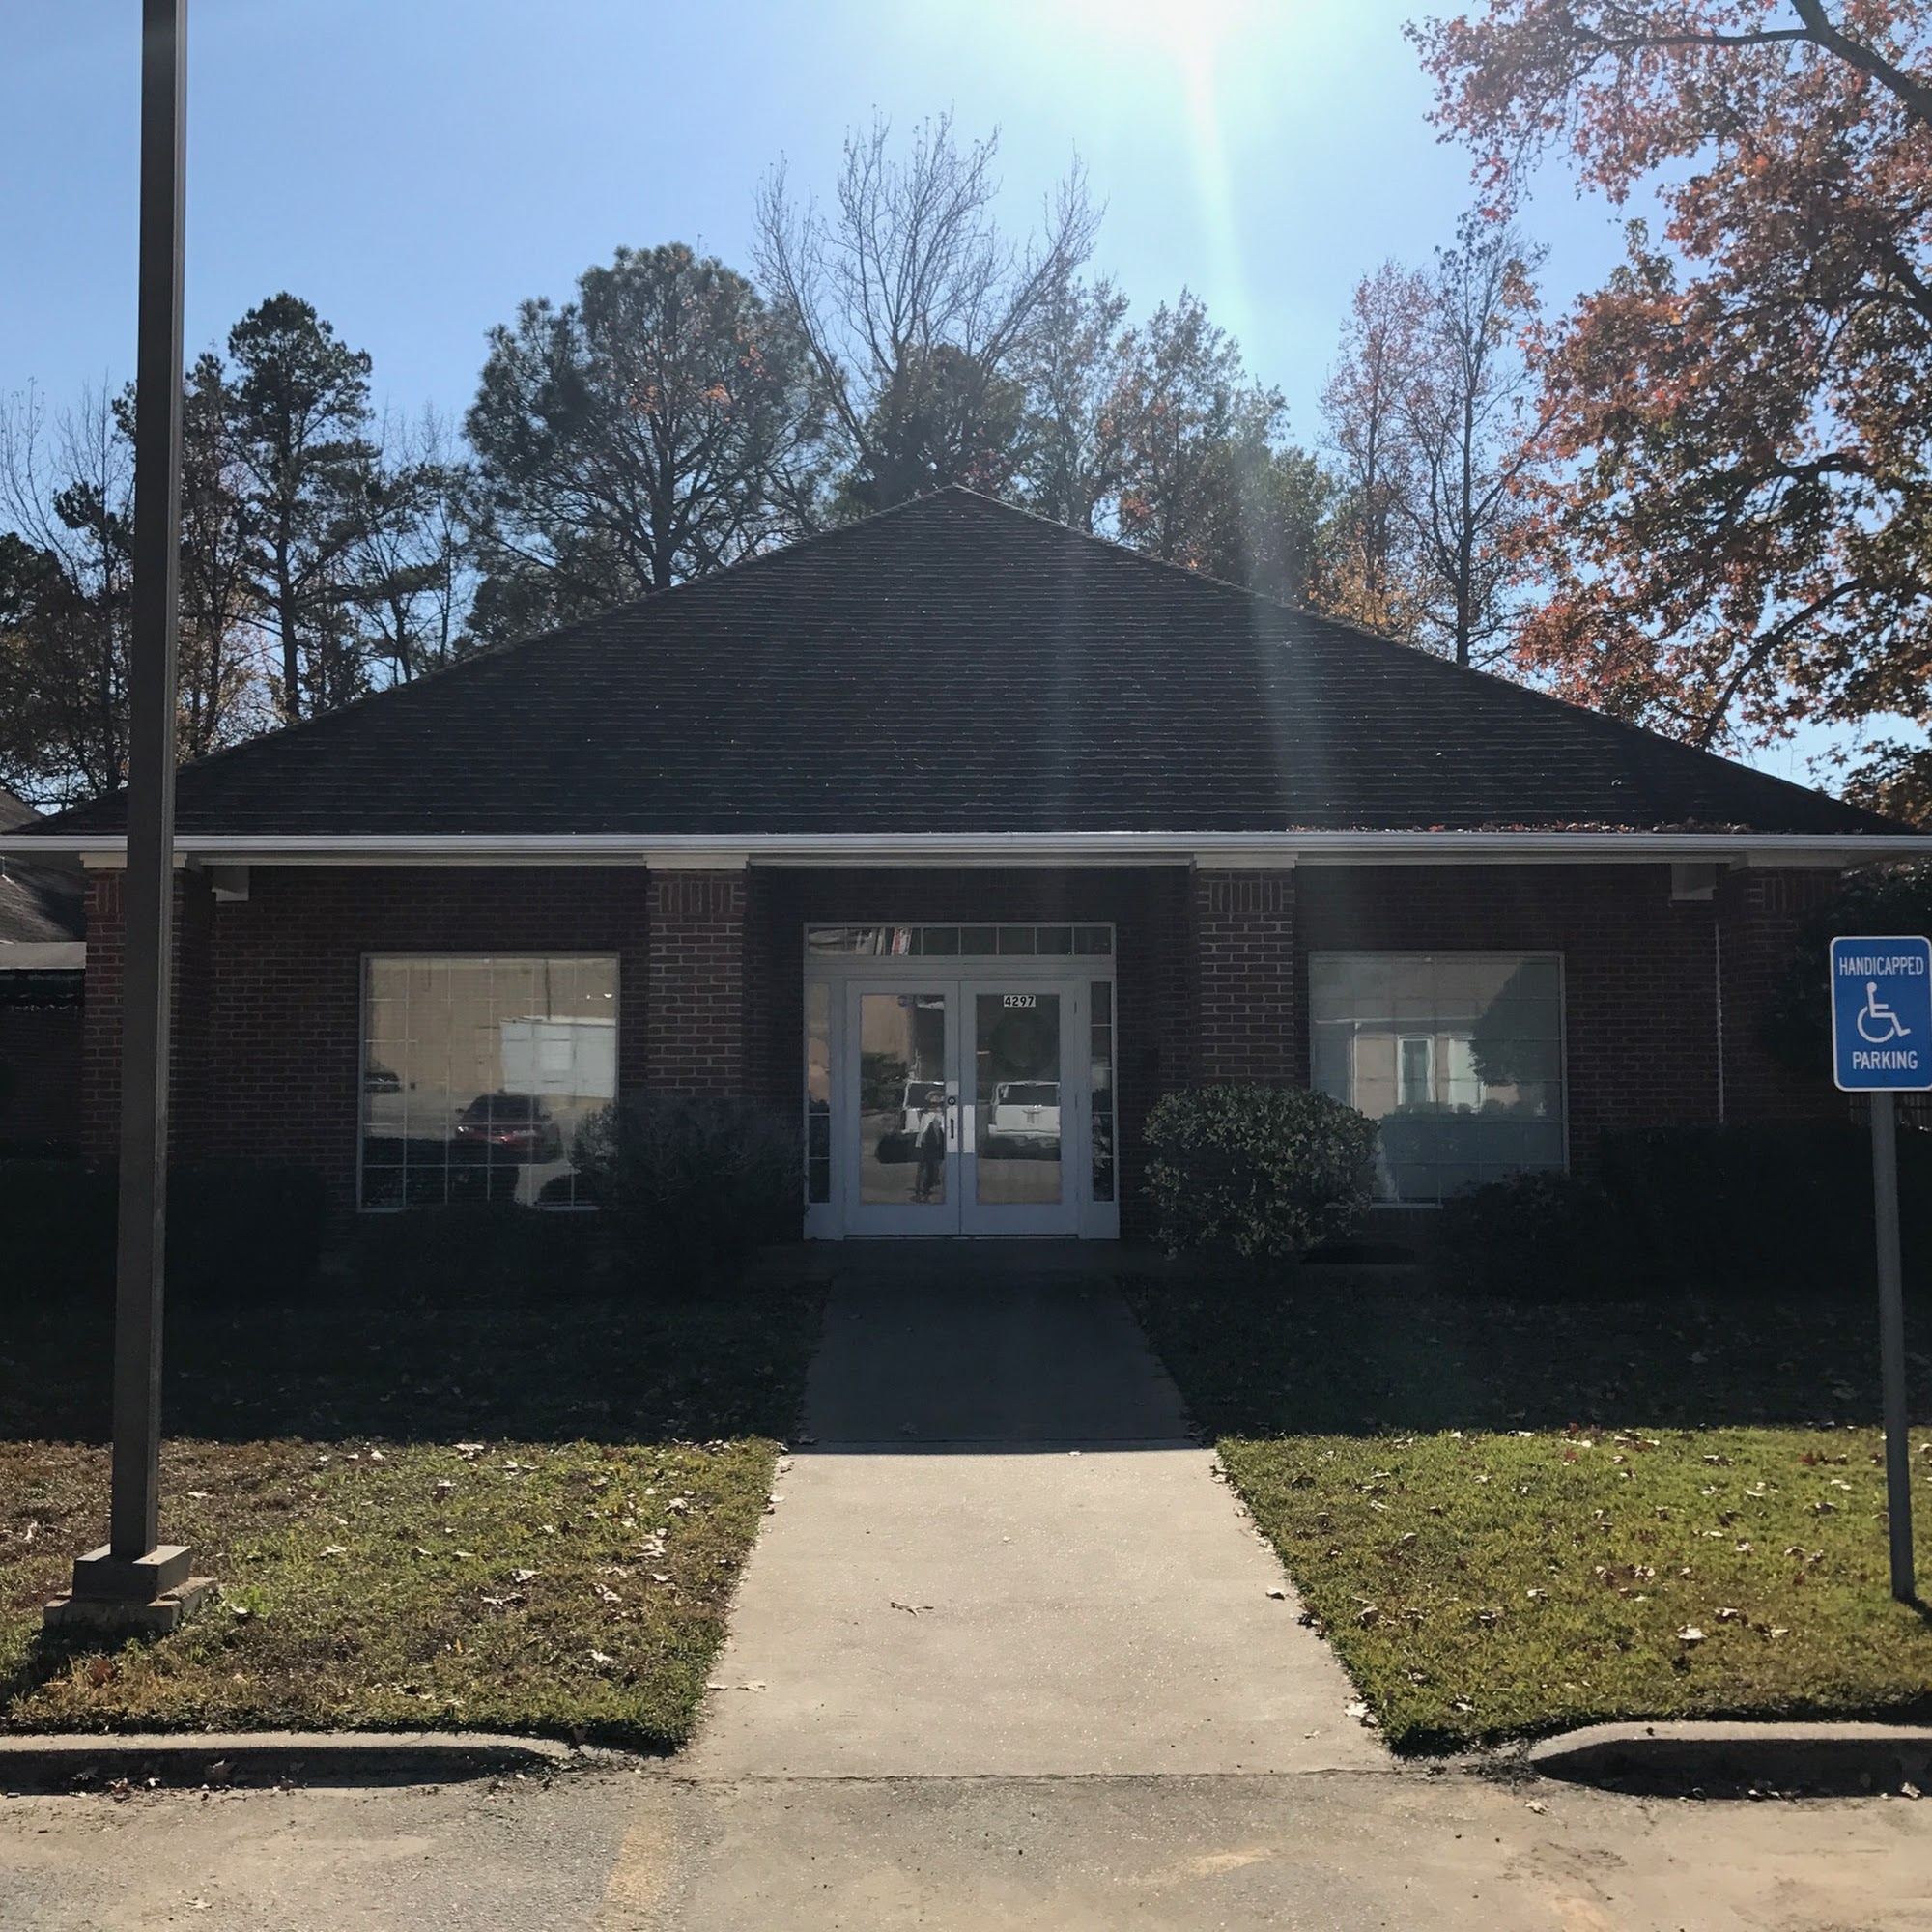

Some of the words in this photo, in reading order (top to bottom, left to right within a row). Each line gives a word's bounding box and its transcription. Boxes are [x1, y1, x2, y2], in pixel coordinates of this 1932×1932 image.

[1839, 956, 1924, 976] HANDICAPPED
[1005, 996, 1034, 1006] 4297
[1852, 1050, 1918, 1069] PARKING
